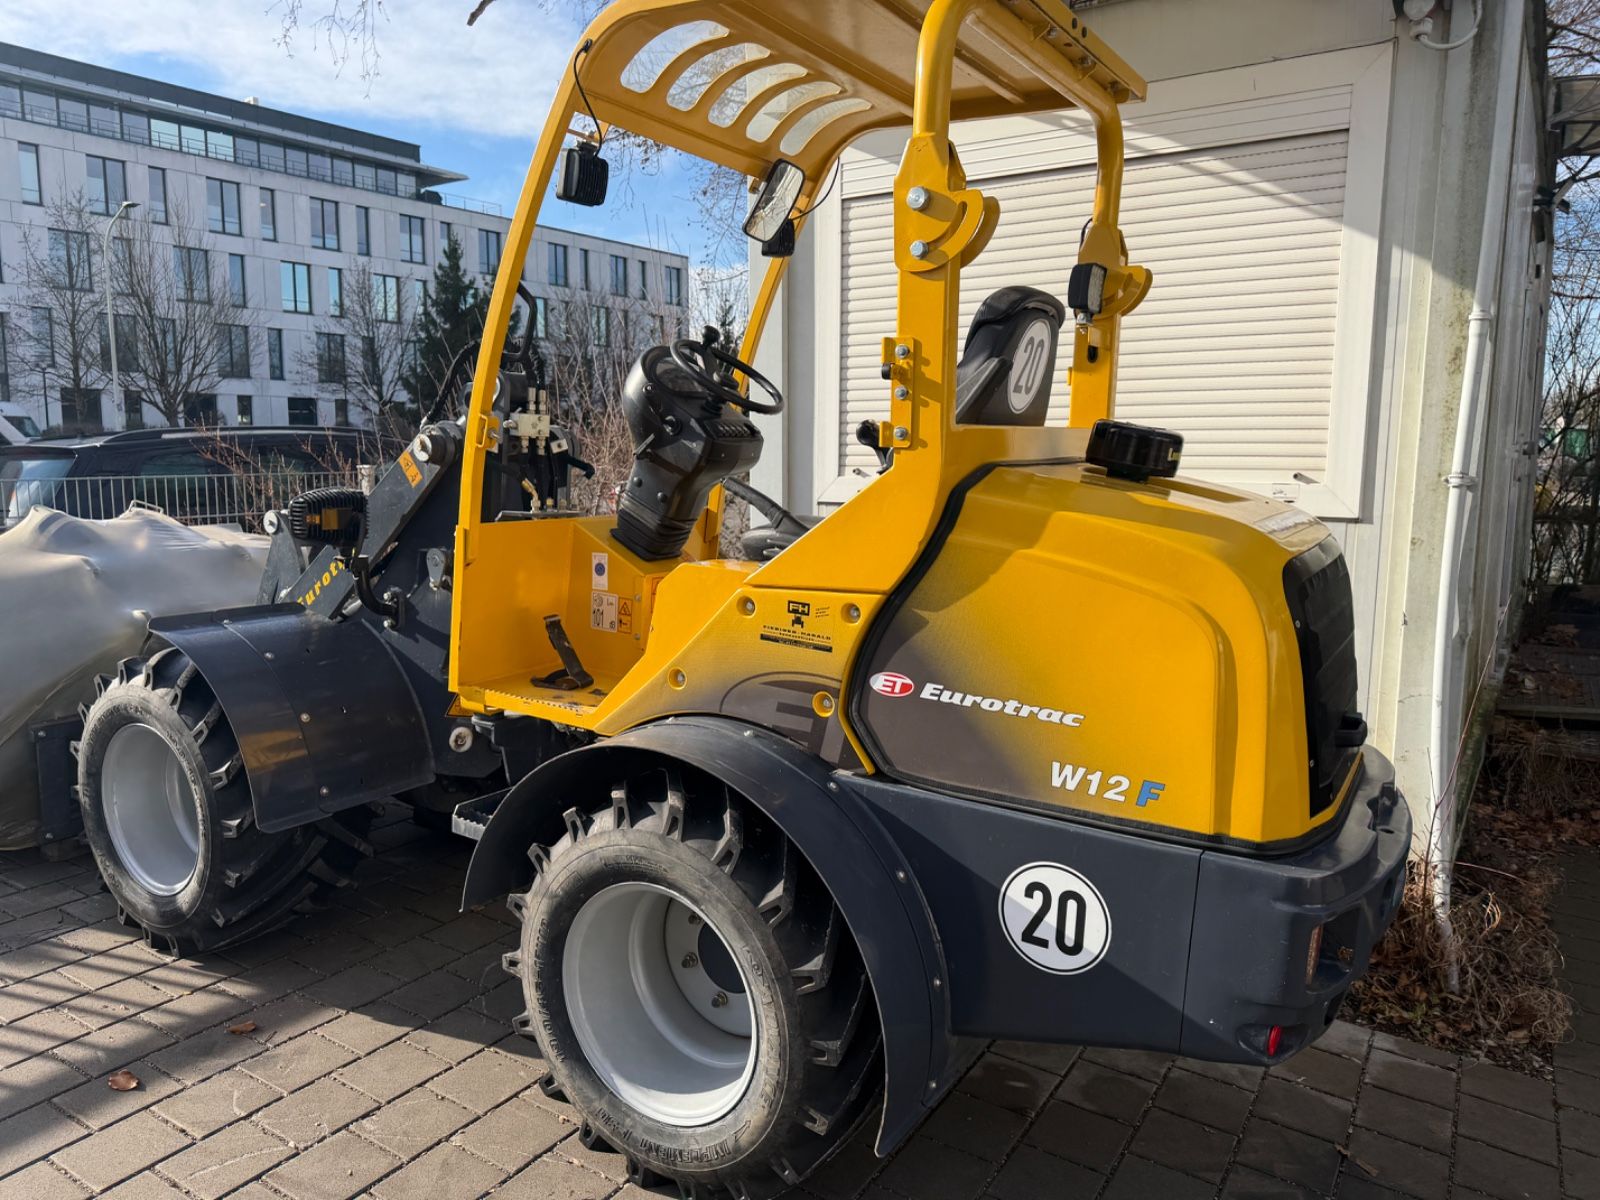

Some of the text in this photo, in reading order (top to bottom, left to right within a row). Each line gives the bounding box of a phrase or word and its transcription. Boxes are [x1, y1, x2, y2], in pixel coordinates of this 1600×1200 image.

[1013, 335, 1045, 395] 20
[873, 674, 905, 694] ET
[919, 682, 1085, 727] Eurotrac
[1051, 761, 1166, 808] W12 F
[1021, 881, 1087, 957] 20
